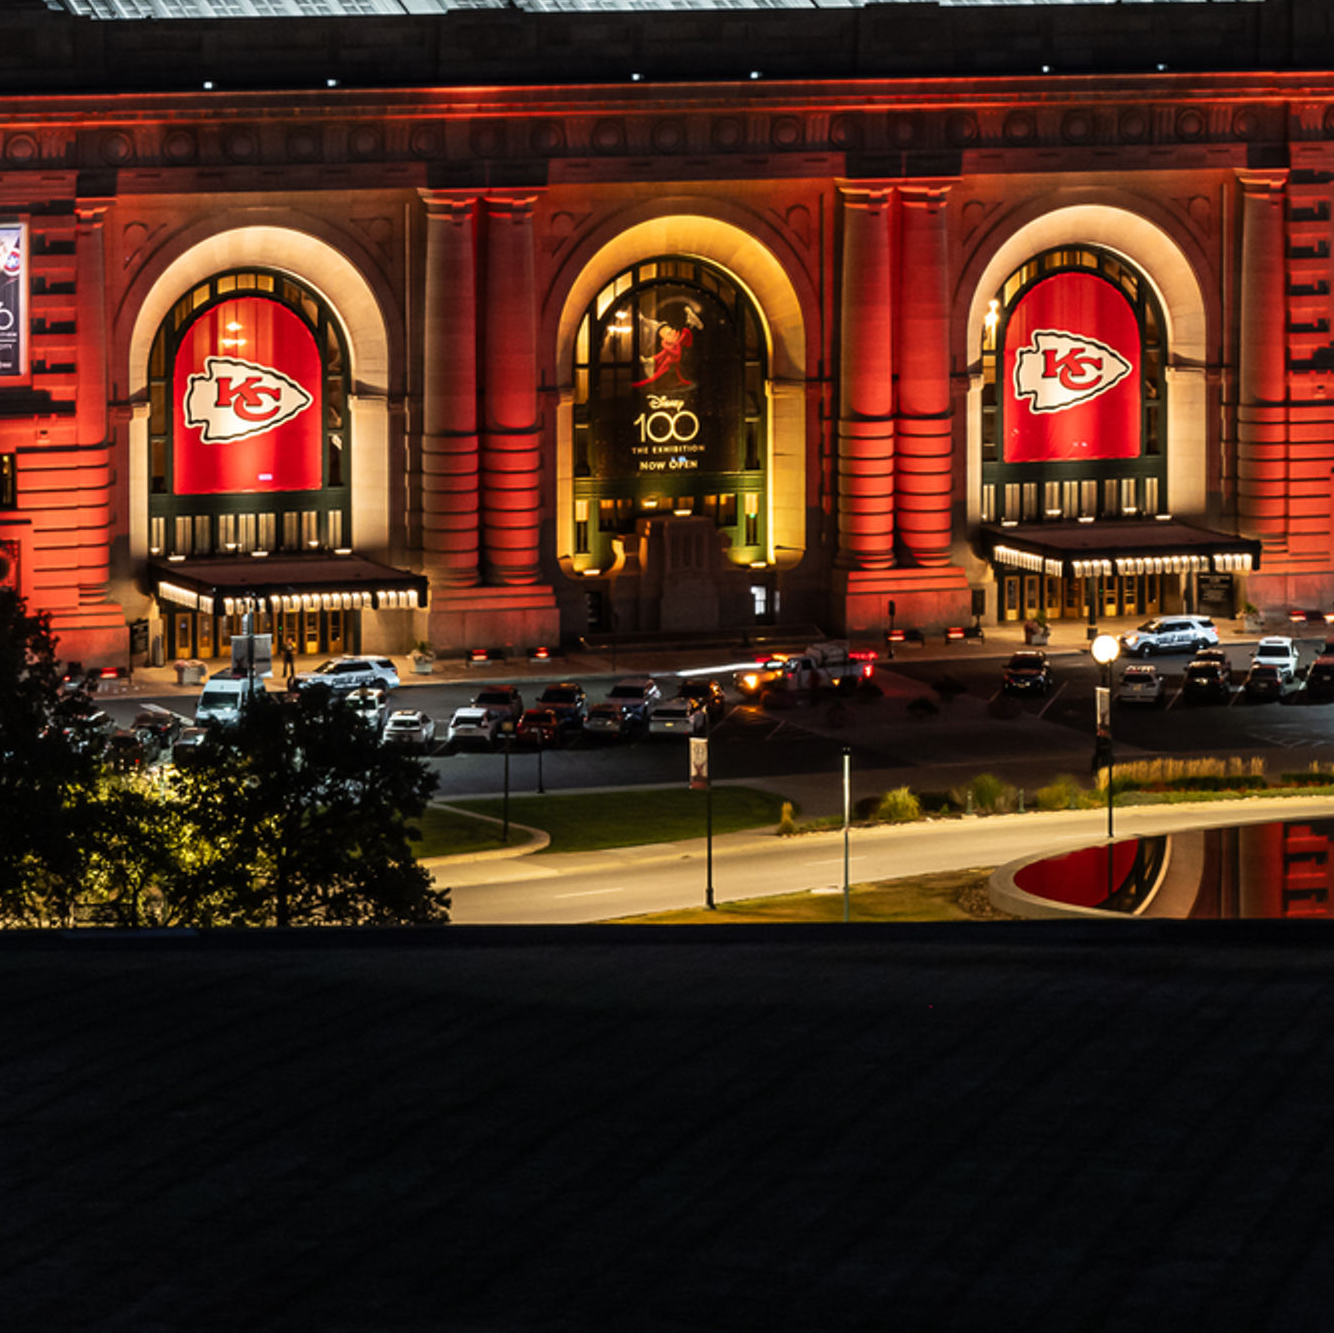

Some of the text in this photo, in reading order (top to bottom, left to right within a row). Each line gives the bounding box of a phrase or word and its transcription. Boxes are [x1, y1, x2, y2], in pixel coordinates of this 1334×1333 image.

[1042, 348, 1103, 391] KC
[215, 377, 281, 422] KC
[646, 395, 685, 412] Disney
[634, 410, 700, 443] 100
[632, 445, 705, 455] THE EXHIBITION
[639, 460, 699, 471] NOW OPEN
